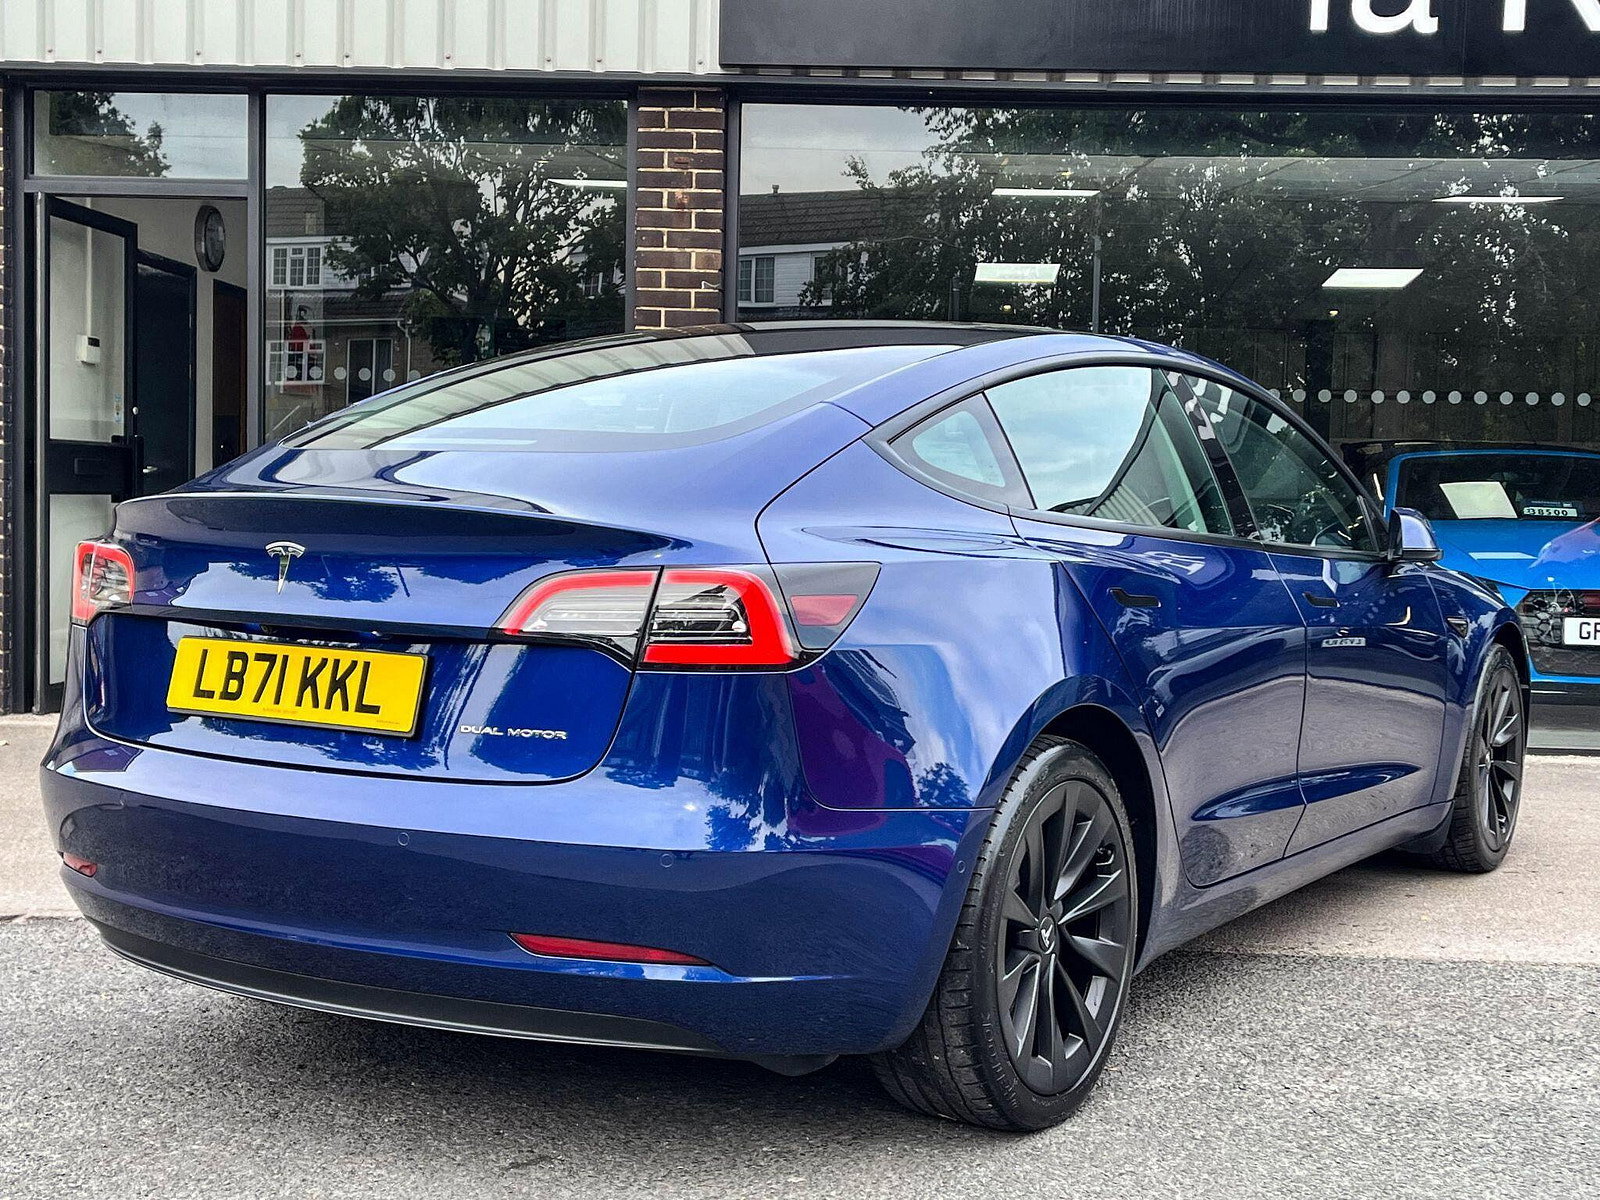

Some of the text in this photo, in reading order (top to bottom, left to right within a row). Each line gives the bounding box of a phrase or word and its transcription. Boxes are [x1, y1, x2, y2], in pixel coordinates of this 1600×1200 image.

[193, 649, 381, 715] LB71 KKL
[460, 725, 568, 740] DUAL MOTOR
